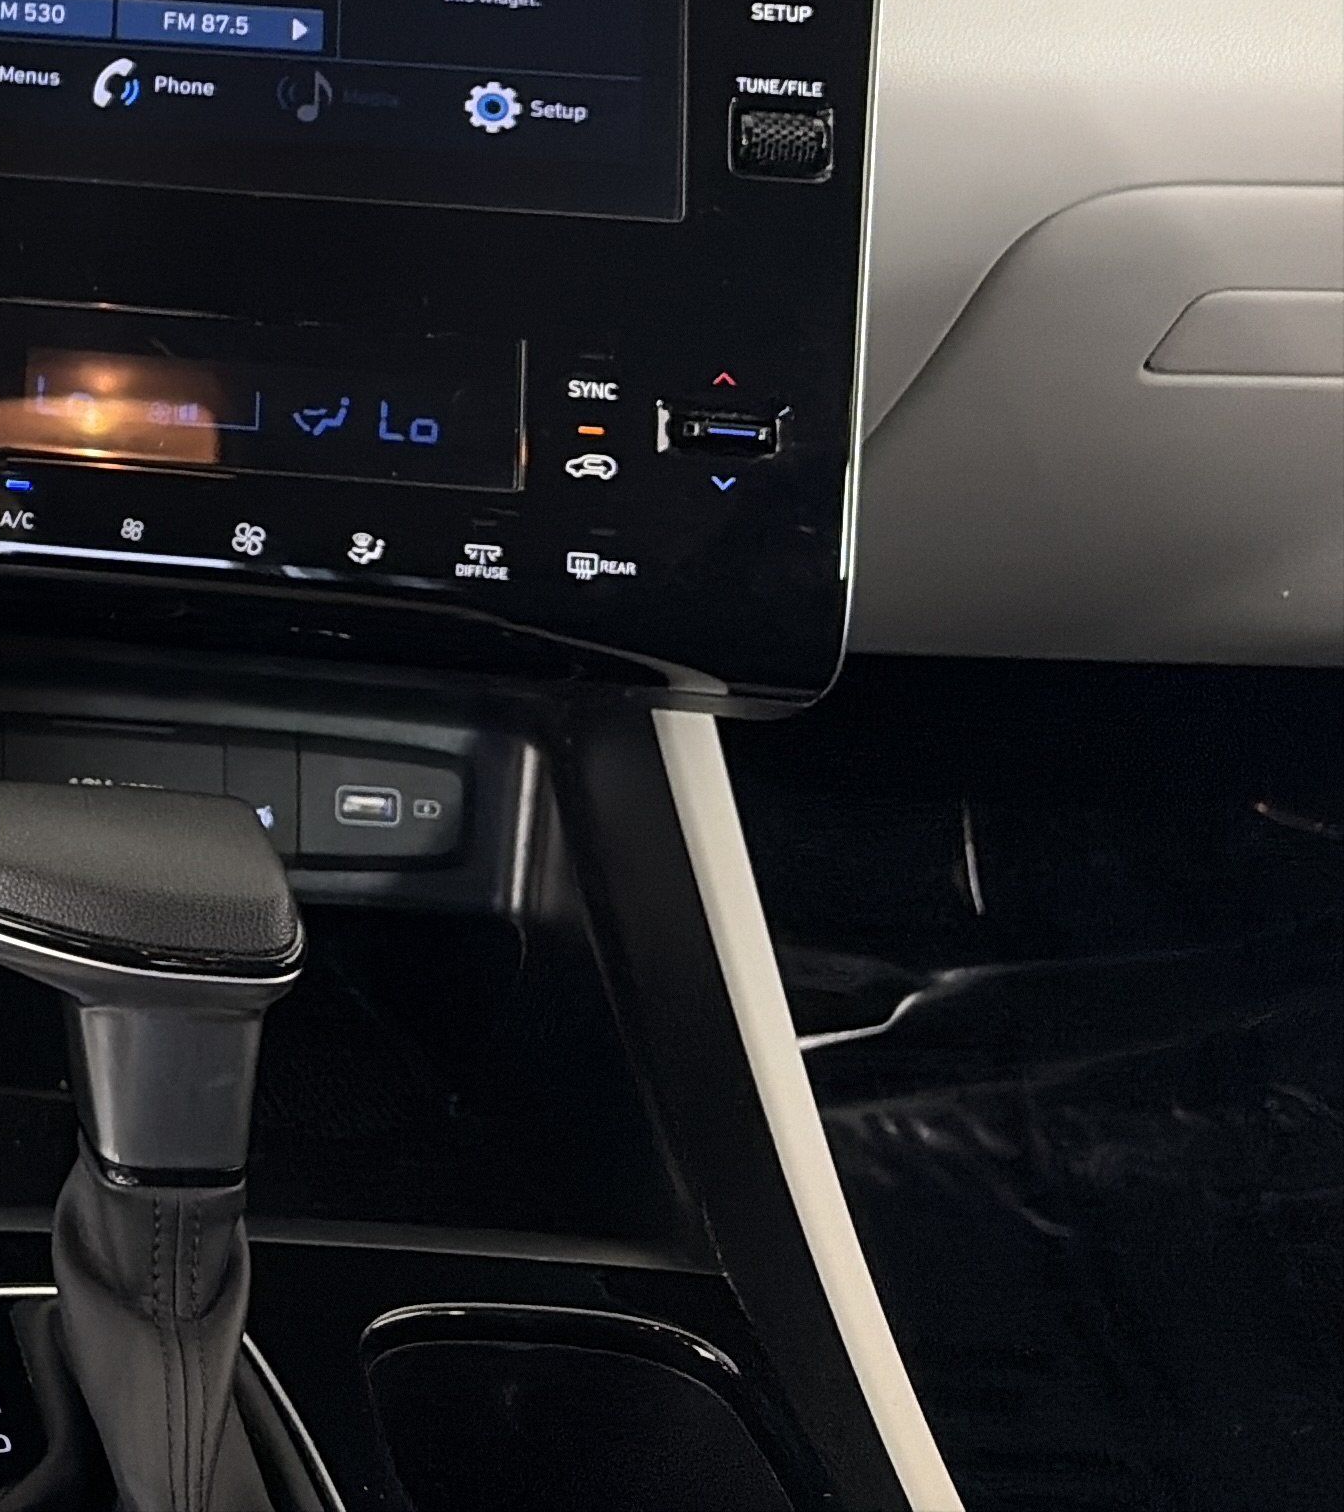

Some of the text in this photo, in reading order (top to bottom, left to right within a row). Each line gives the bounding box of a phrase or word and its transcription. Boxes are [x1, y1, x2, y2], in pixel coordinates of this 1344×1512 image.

[24, 3, 66, 25] 530
[163, 11, 250, 36] FM 87.5
[751, 3, 813, 23] SETUP
[0, 65, 62, 88] Menus
[154, 75, 215, 97] Phone
[736, 77, 823, 97] TUNE/FILE
[529, 99, 589, 123] Setup
[567, 380, 618, 402] SYNC
[0, 511, 35, 531] A/C
[455, 563, 509, 581] DIFFUSE
[600, 559, 637, 577] REAR
